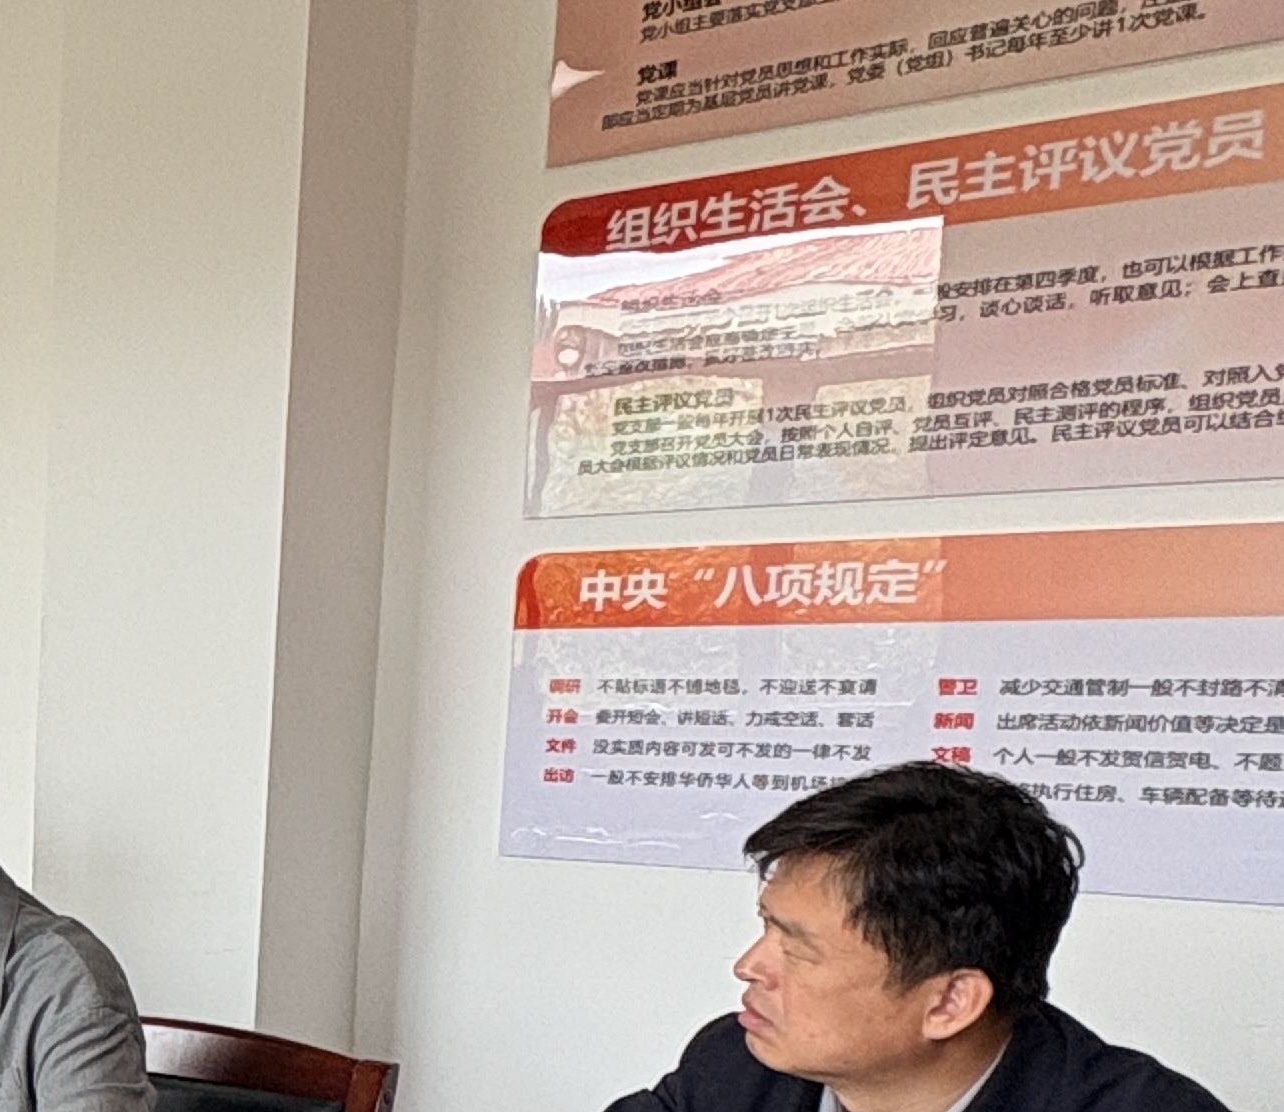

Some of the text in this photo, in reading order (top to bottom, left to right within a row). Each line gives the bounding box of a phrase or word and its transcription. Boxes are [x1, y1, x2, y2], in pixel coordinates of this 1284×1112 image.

[638, 60, 678, 86] 党课
[606, 110, 1264, 252] 组织生活会、民主评议党员
[579, 558, 948, 611] 中央“八项规定”
[938, 678, 979, 697] 警卫
[933, 712, 975, 730] 新闻
[545, 738, 577, 753] 文件
[543, 767, 575, 784] 出访
